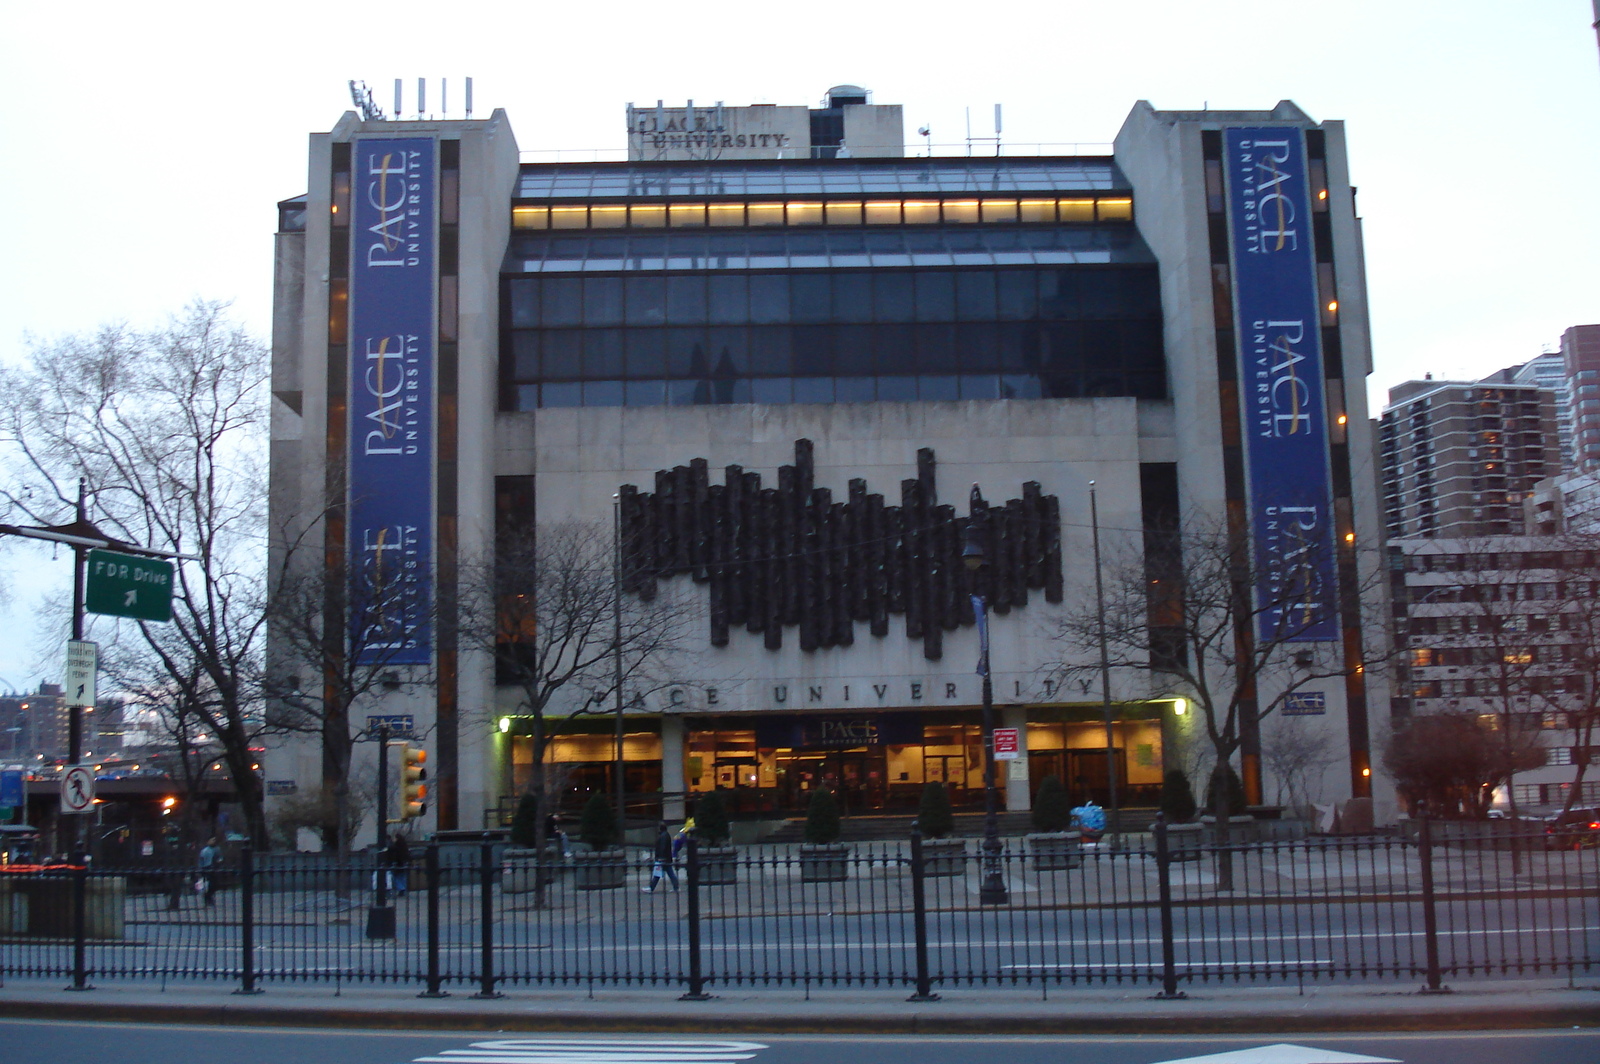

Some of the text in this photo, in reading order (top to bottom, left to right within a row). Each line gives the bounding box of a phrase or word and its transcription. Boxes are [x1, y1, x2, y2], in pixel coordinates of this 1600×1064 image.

[653, 133, 786, 149] UNIVERSITY
[1239, 139, 1260, 255] UNIVERSITY
[1252, 139, 1298, 255] PACE
[367, 151, 407, 268] PACE
[408, 150, 422, 267] UNIVERSITY
[364, 334, 405, 457] PACE
[405, 333, 419, 456] UNIVERSITY
[1252, 320, 1273, 439] UNIVERSITY
[1266, 318, 1313, 439] PACE
[95, 561, 168, 585] FDR Drive
[363, 525, 403, 651] PACE
[773, 678, 1092, 703] UNIVERITY
[820, 719, 879, 739] PACE
